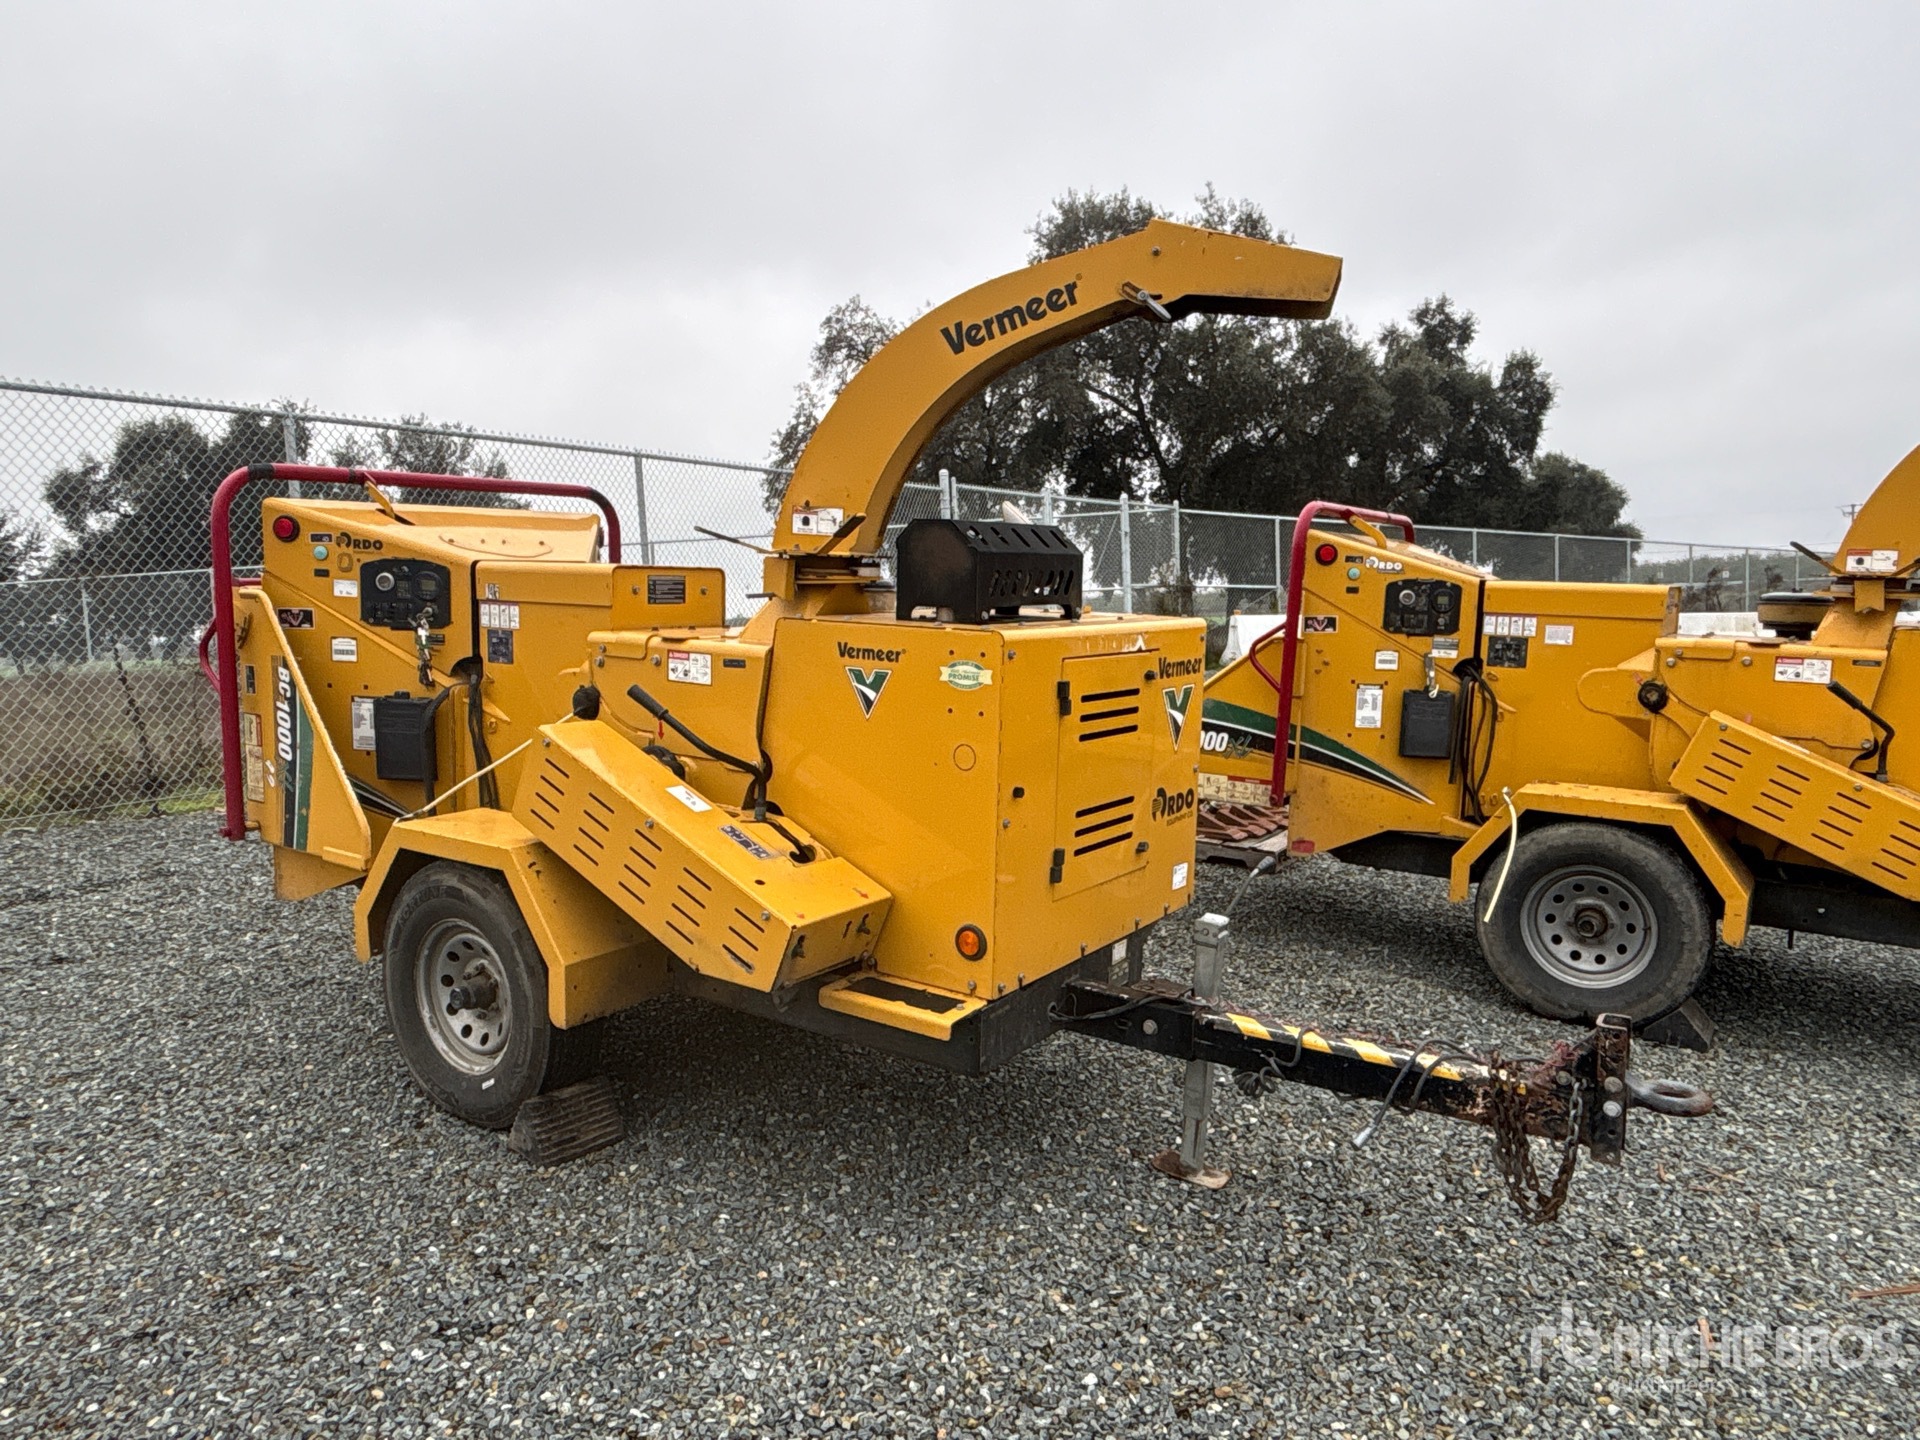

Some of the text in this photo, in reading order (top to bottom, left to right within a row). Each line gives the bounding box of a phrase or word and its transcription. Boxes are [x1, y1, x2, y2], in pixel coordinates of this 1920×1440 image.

[940, 281, 1078, 355] Vermeer
[837, 641, 902, 662] Vermeer
[1158, 656, 1202, 680] Vermeer
